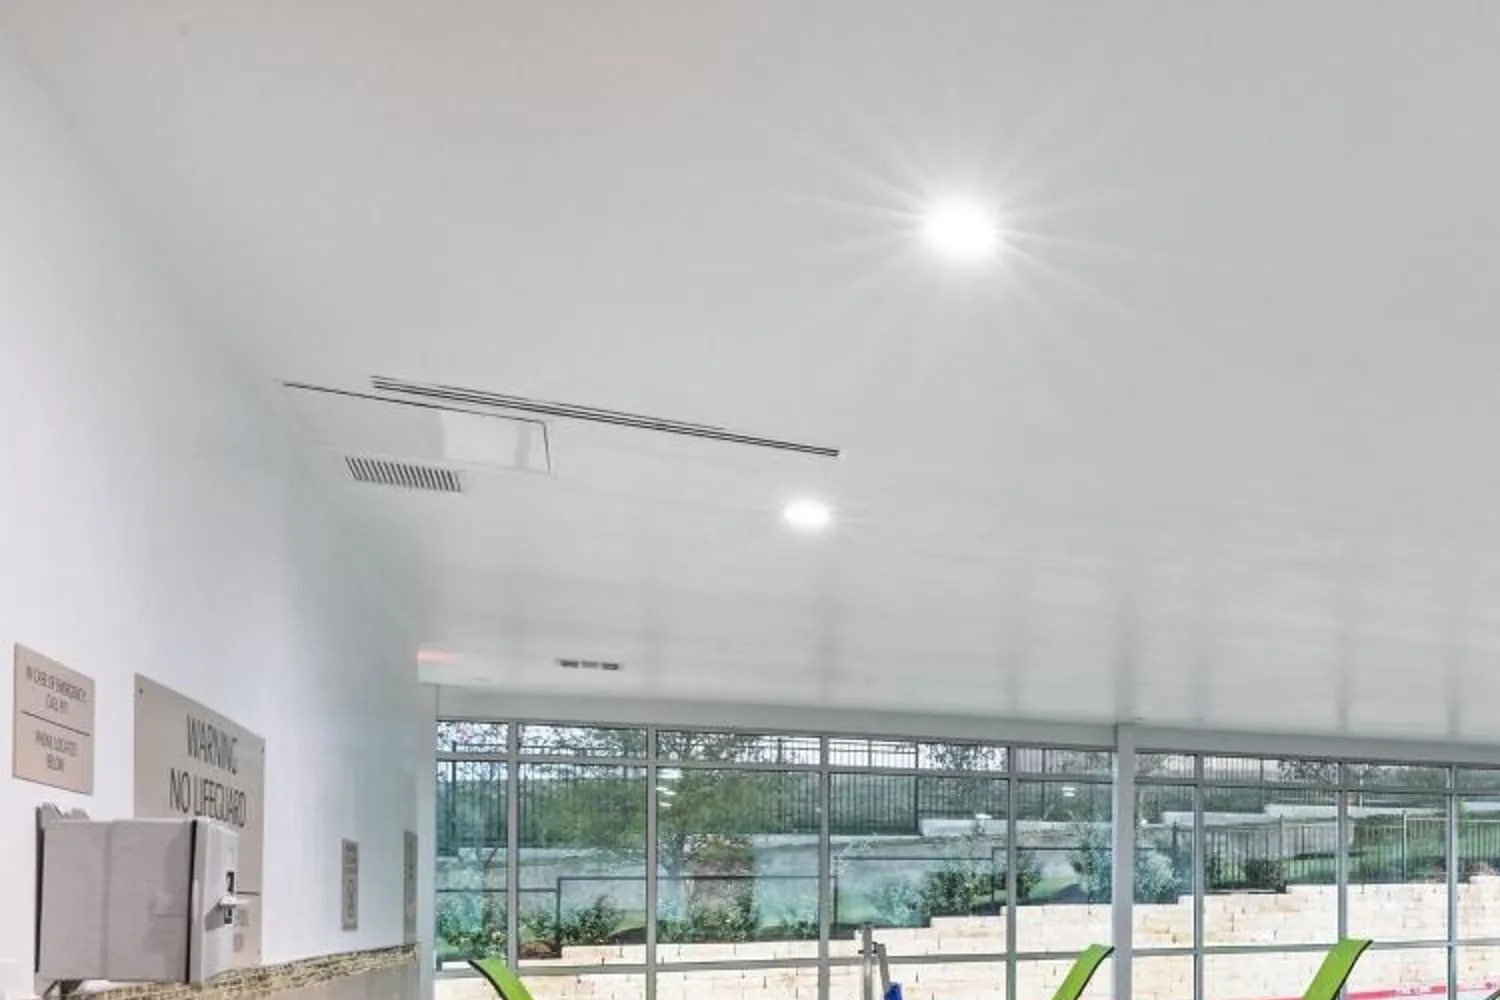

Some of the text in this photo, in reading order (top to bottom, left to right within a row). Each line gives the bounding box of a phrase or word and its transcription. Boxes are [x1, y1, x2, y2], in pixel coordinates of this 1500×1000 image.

[187, 713, 239, 775] WARNING
[169, 767, 248, 828] NO LIFEGUARD
